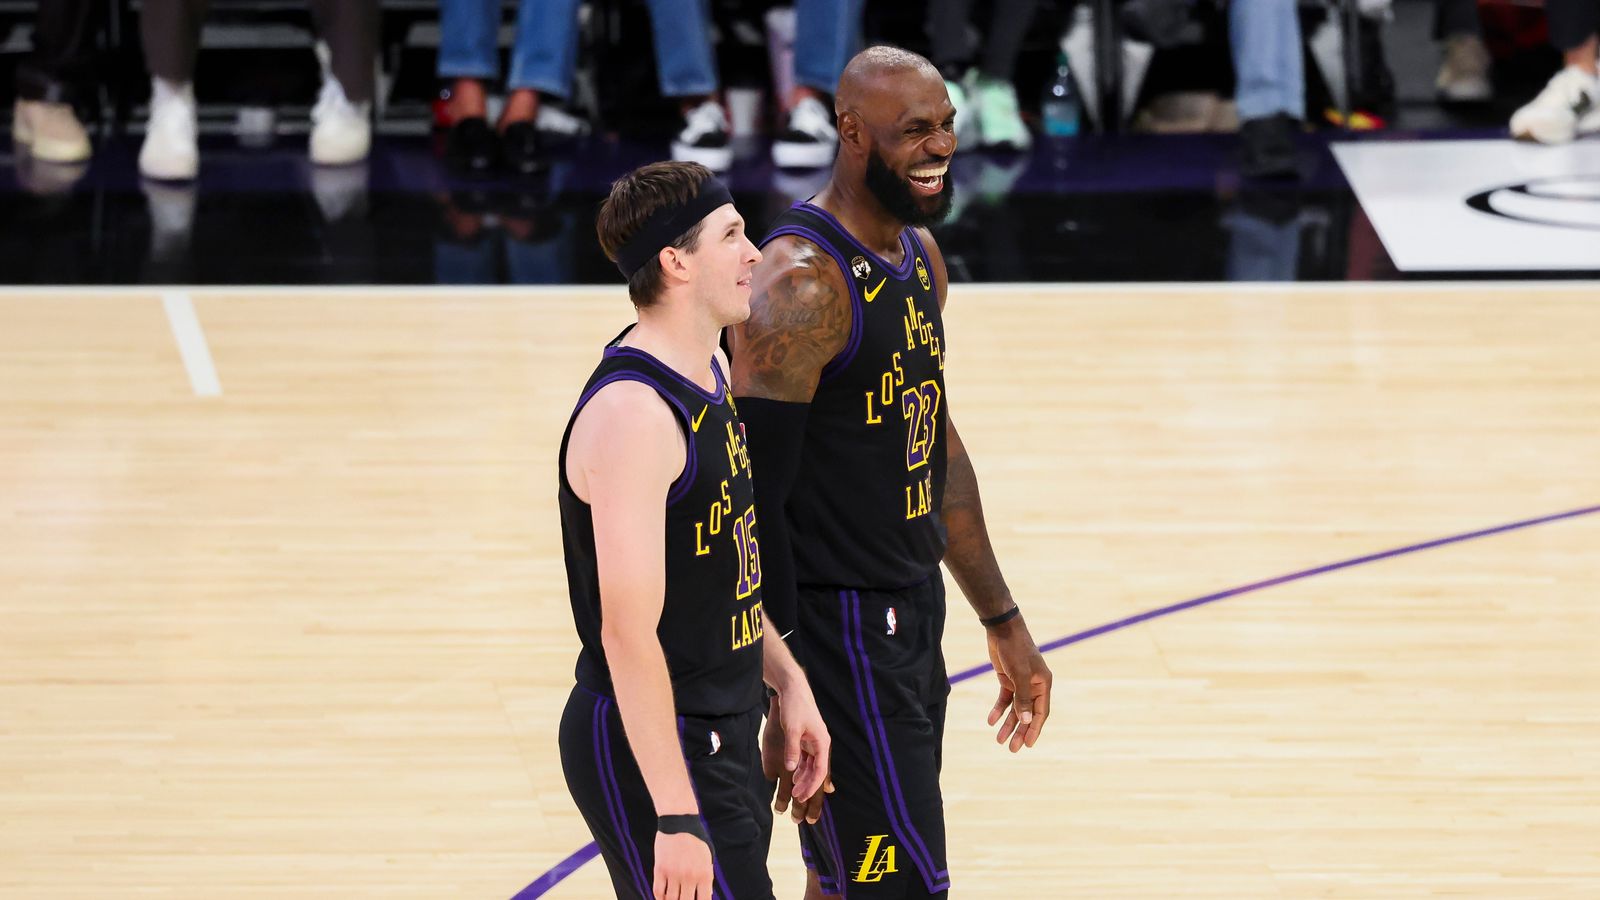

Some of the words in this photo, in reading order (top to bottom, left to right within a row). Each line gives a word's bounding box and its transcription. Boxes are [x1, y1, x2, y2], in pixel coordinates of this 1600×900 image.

[866, 352, 904, 424] LOS
[904, 297, 945, 370] ANGEL
[902, 380, 941, 471] 23
[695, 480, 732, 556] LOS
[733, 504, 762, 600] 15
[732, 600, 763, 650] LAKE
[850, 835, 899, 882] LA
